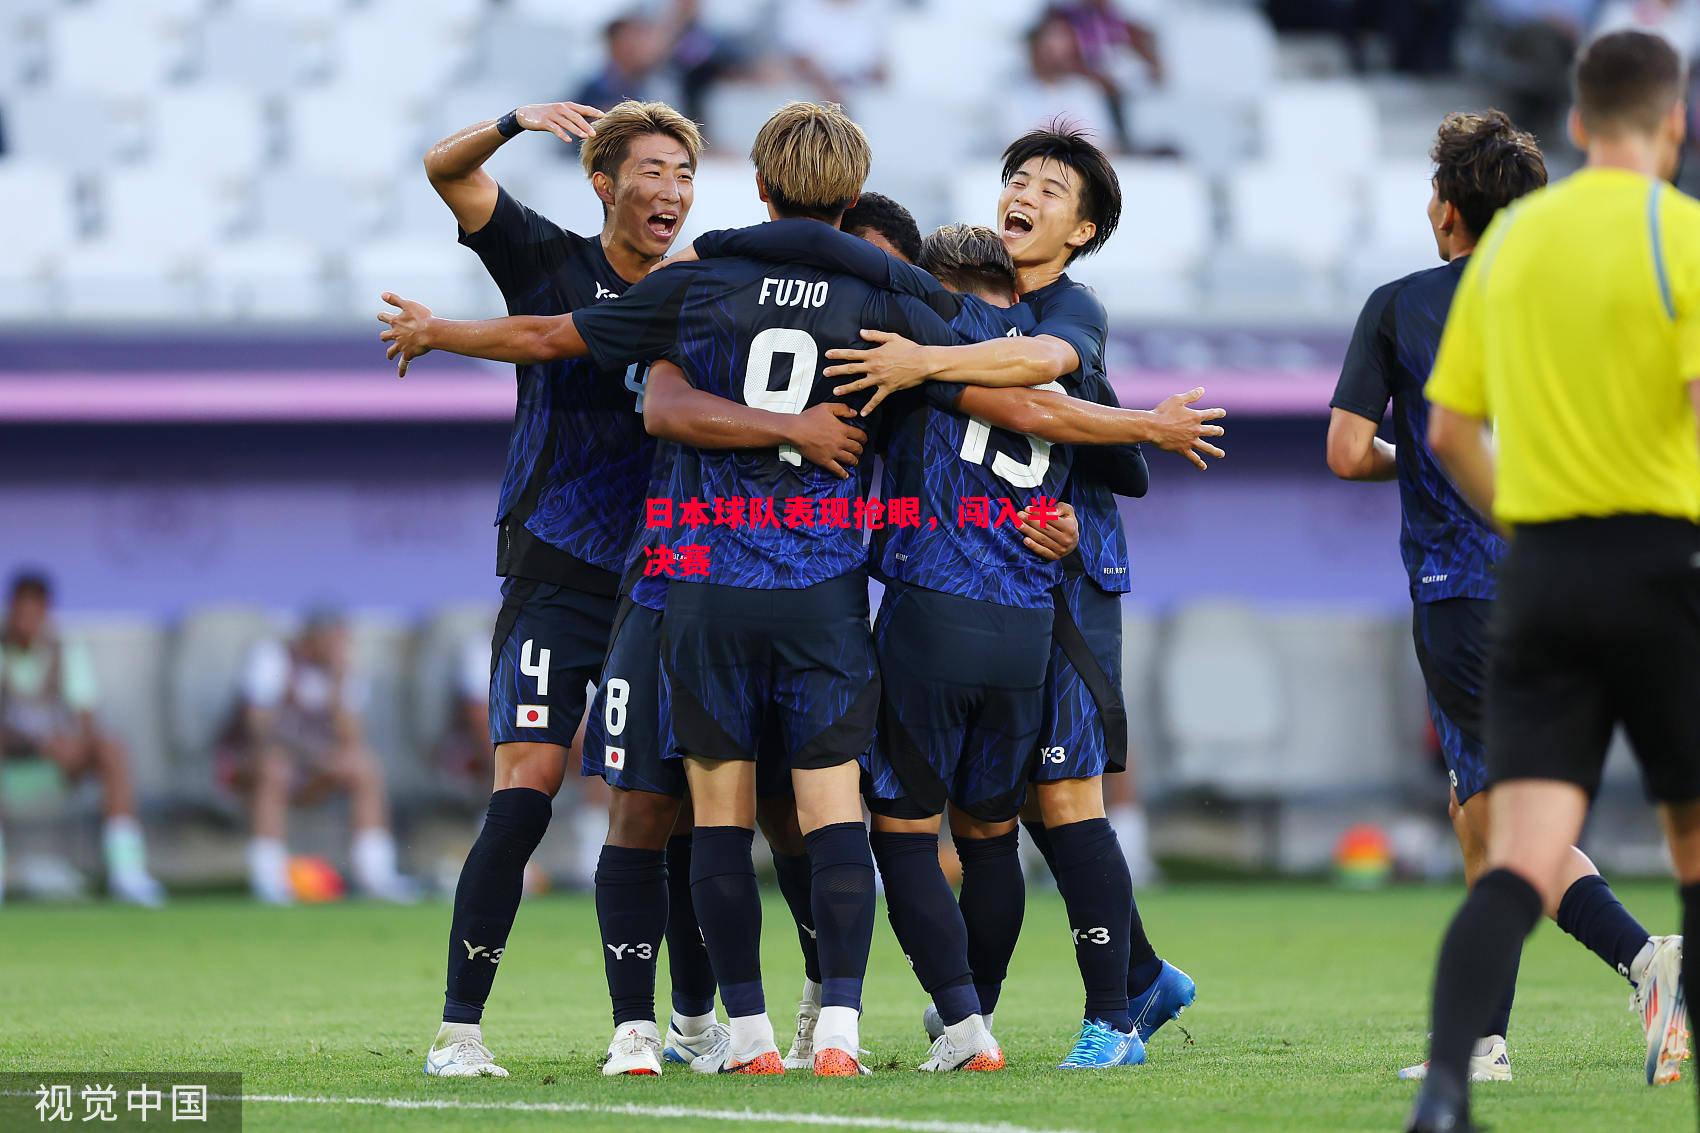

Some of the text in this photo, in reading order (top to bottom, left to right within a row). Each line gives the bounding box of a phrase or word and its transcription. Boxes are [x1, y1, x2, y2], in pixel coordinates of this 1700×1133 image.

[758, 277, 829, 309] FUJIO
[743, 328, 818, 467] 9
[520, 638, 551, 696] 4
[605, 677, 630, 737] 8
[1040, 746, 1066, 765] Y-3
[606, 942, 653, 961] Y-3
